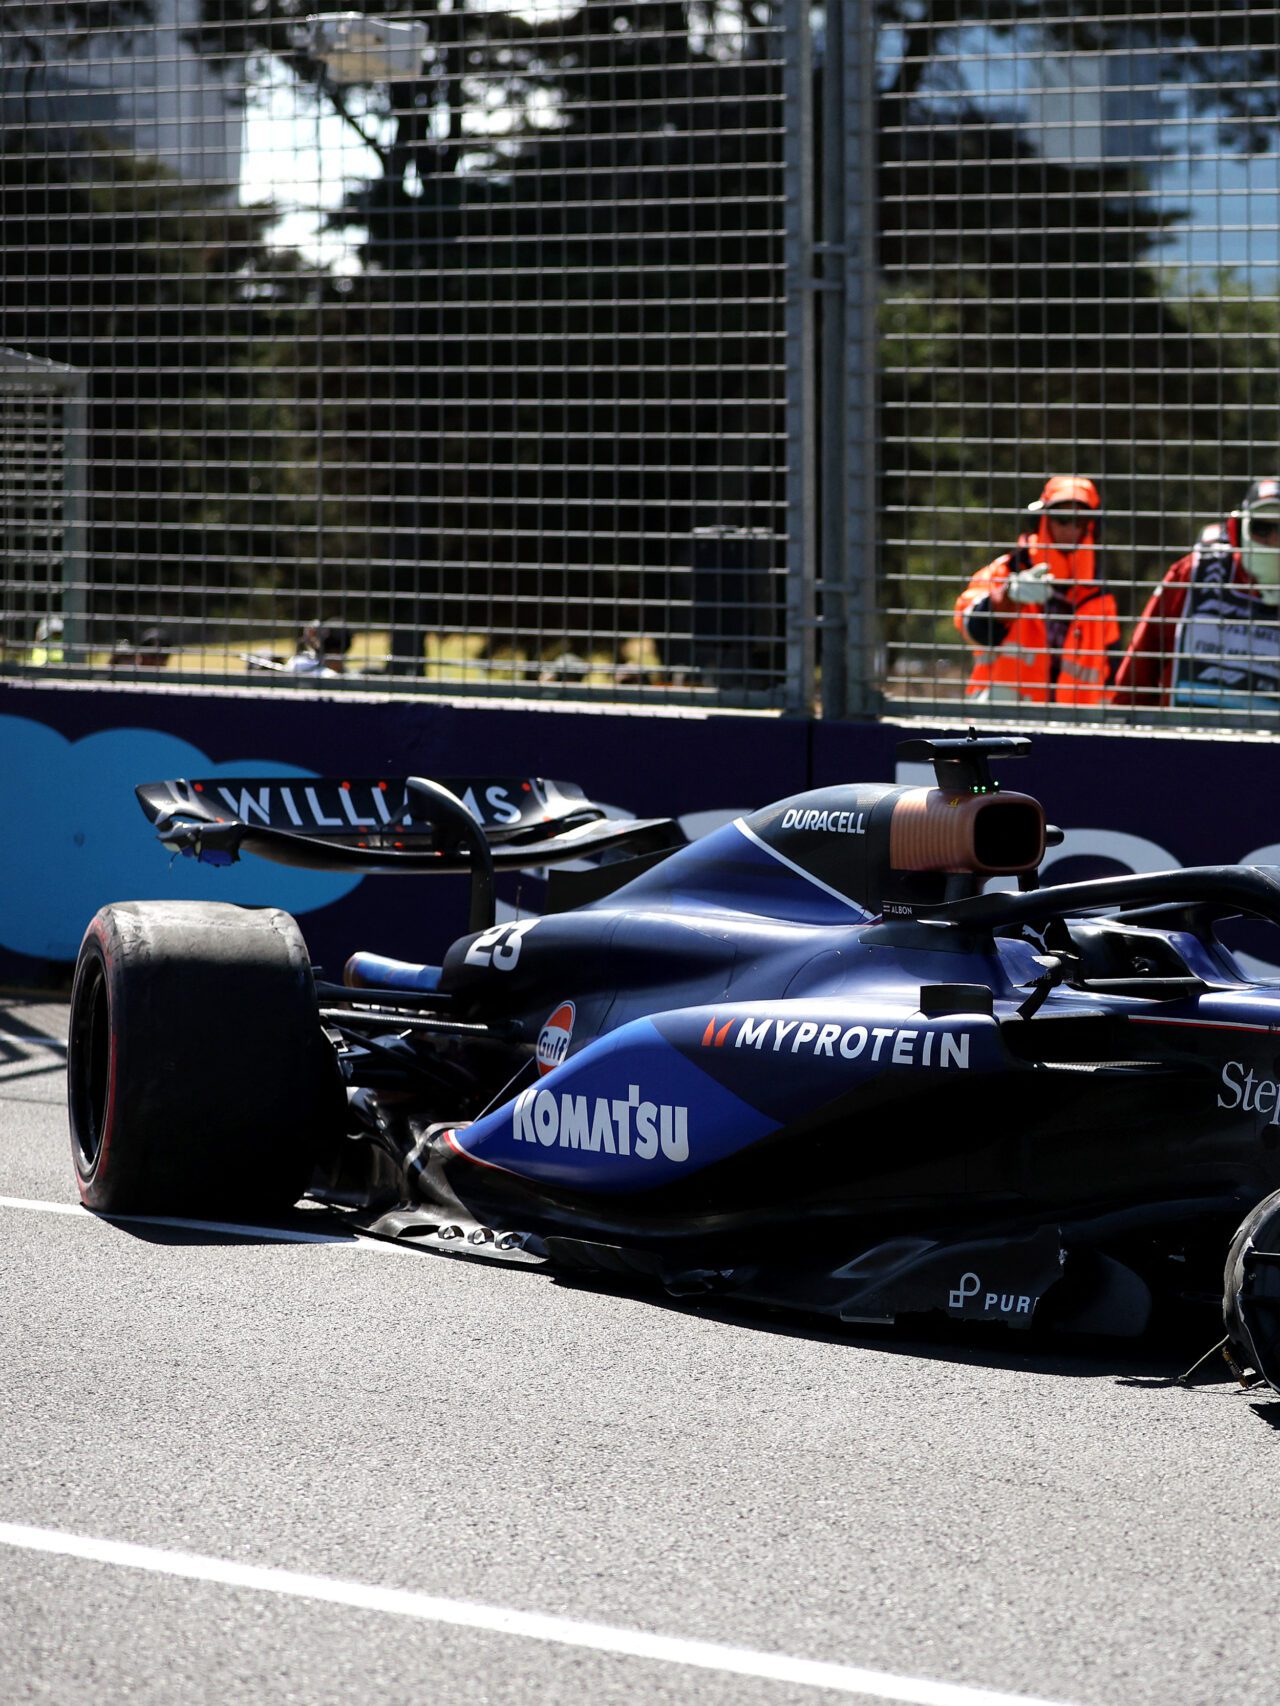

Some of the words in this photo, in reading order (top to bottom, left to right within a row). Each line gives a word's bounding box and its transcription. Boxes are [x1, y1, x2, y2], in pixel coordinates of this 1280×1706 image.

[781, 809, 865, 835] DURACELL
[891, 906, 913, 915] ALBON
[464, 918, 541, 971] 23
[538, 1030, 568, 1062] Gulf
[735, 1017, 970, 1069] MYPROTEIN
[512, 1084, 690, 1162] KOMATSU
